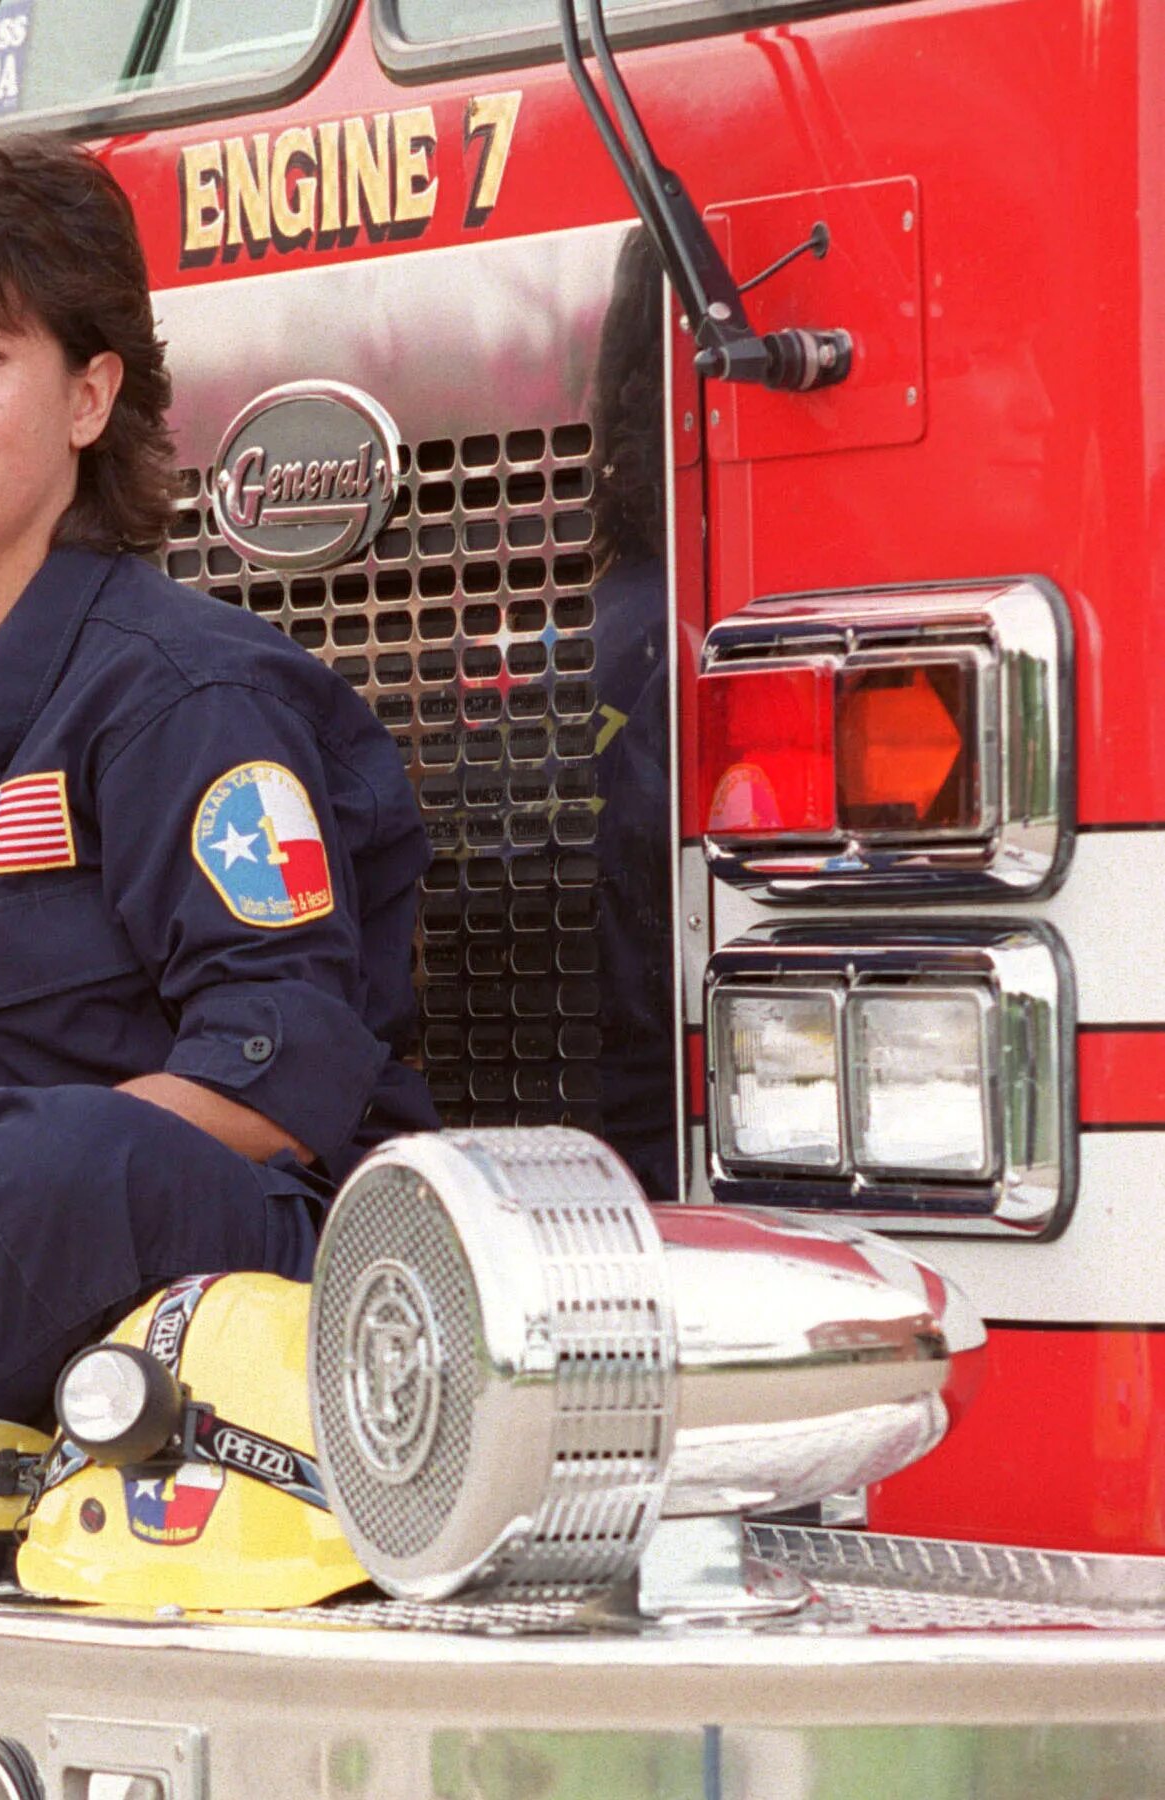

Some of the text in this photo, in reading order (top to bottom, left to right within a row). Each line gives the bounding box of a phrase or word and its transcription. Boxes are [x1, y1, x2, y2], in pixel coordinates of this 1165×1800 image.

[179, 90, 522, 262] ENGINE 7
[225, 440, 373, 528] General
[258, 815, 290, 865] 1
[297, 892, 307, 911] &
[219, 1430, 295, 1481] PETZL
